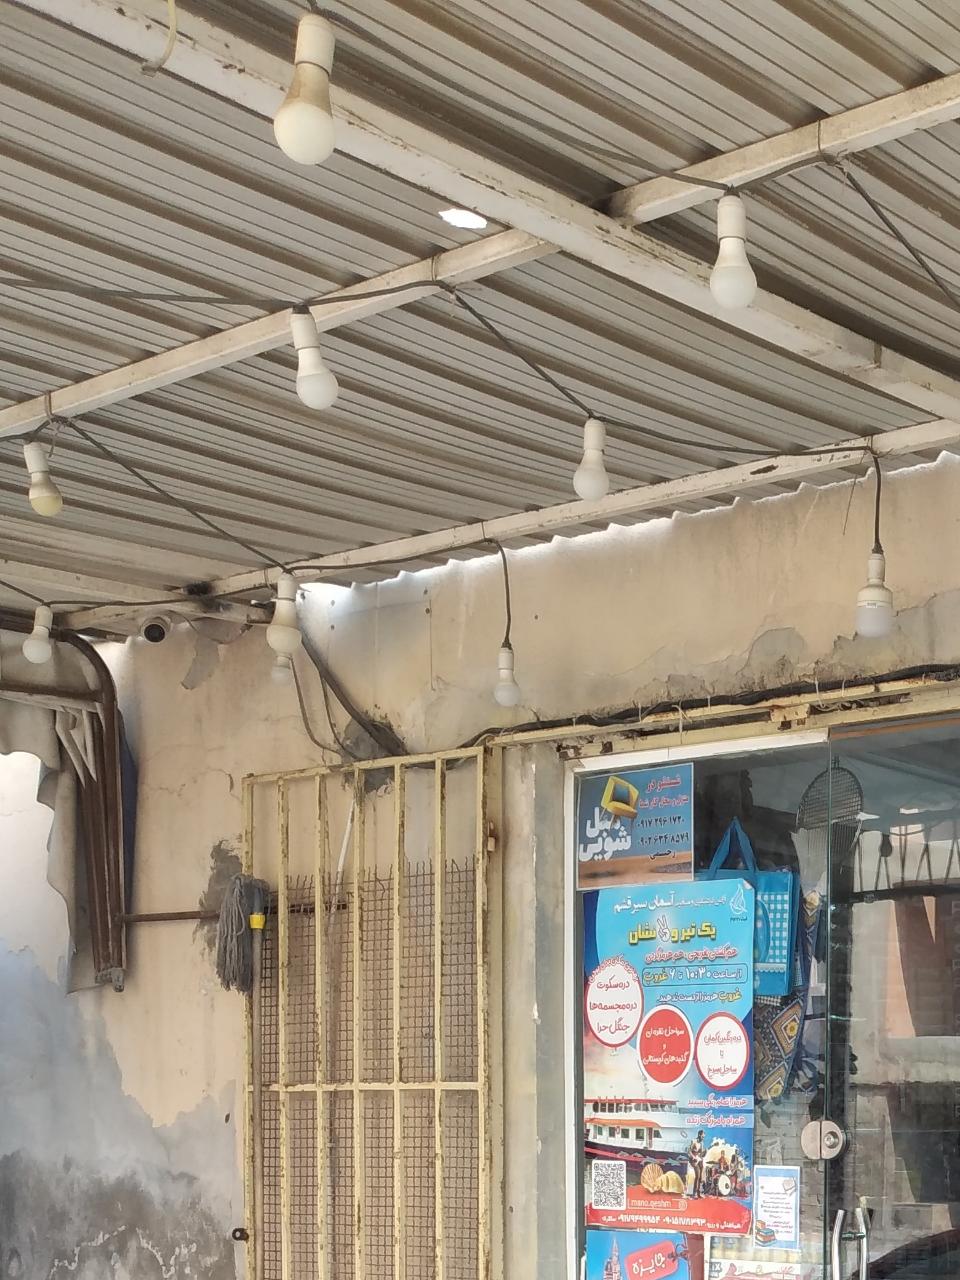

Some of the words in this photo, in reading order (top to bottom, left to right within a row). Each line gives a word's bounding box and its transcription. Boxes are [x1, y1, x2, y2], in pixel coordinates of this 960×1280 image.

[586, 806, 622, 838] مبل
[579, 826, 632, 862] شویی
[613, 896, 632, 913] قشم
[630, 899, 649, 914] سیر
[648, 890, 674, 911] آسمان
[628, 922, 657, 946] نشان
[670, 928, 680, 943] و
[680, 922, 698, 943] تیر
[697, 921, 717, 941] یک
[596, 974, 620, 992] سکوت
[643, 967, 668, 985] غروب
[718, 987, 742, 1003] غروب
[597, 1021, 612, 1033] حرا
[609, 1016, 631, 1035] جنگل
[632, 1252, 666, 1278] جایزه
